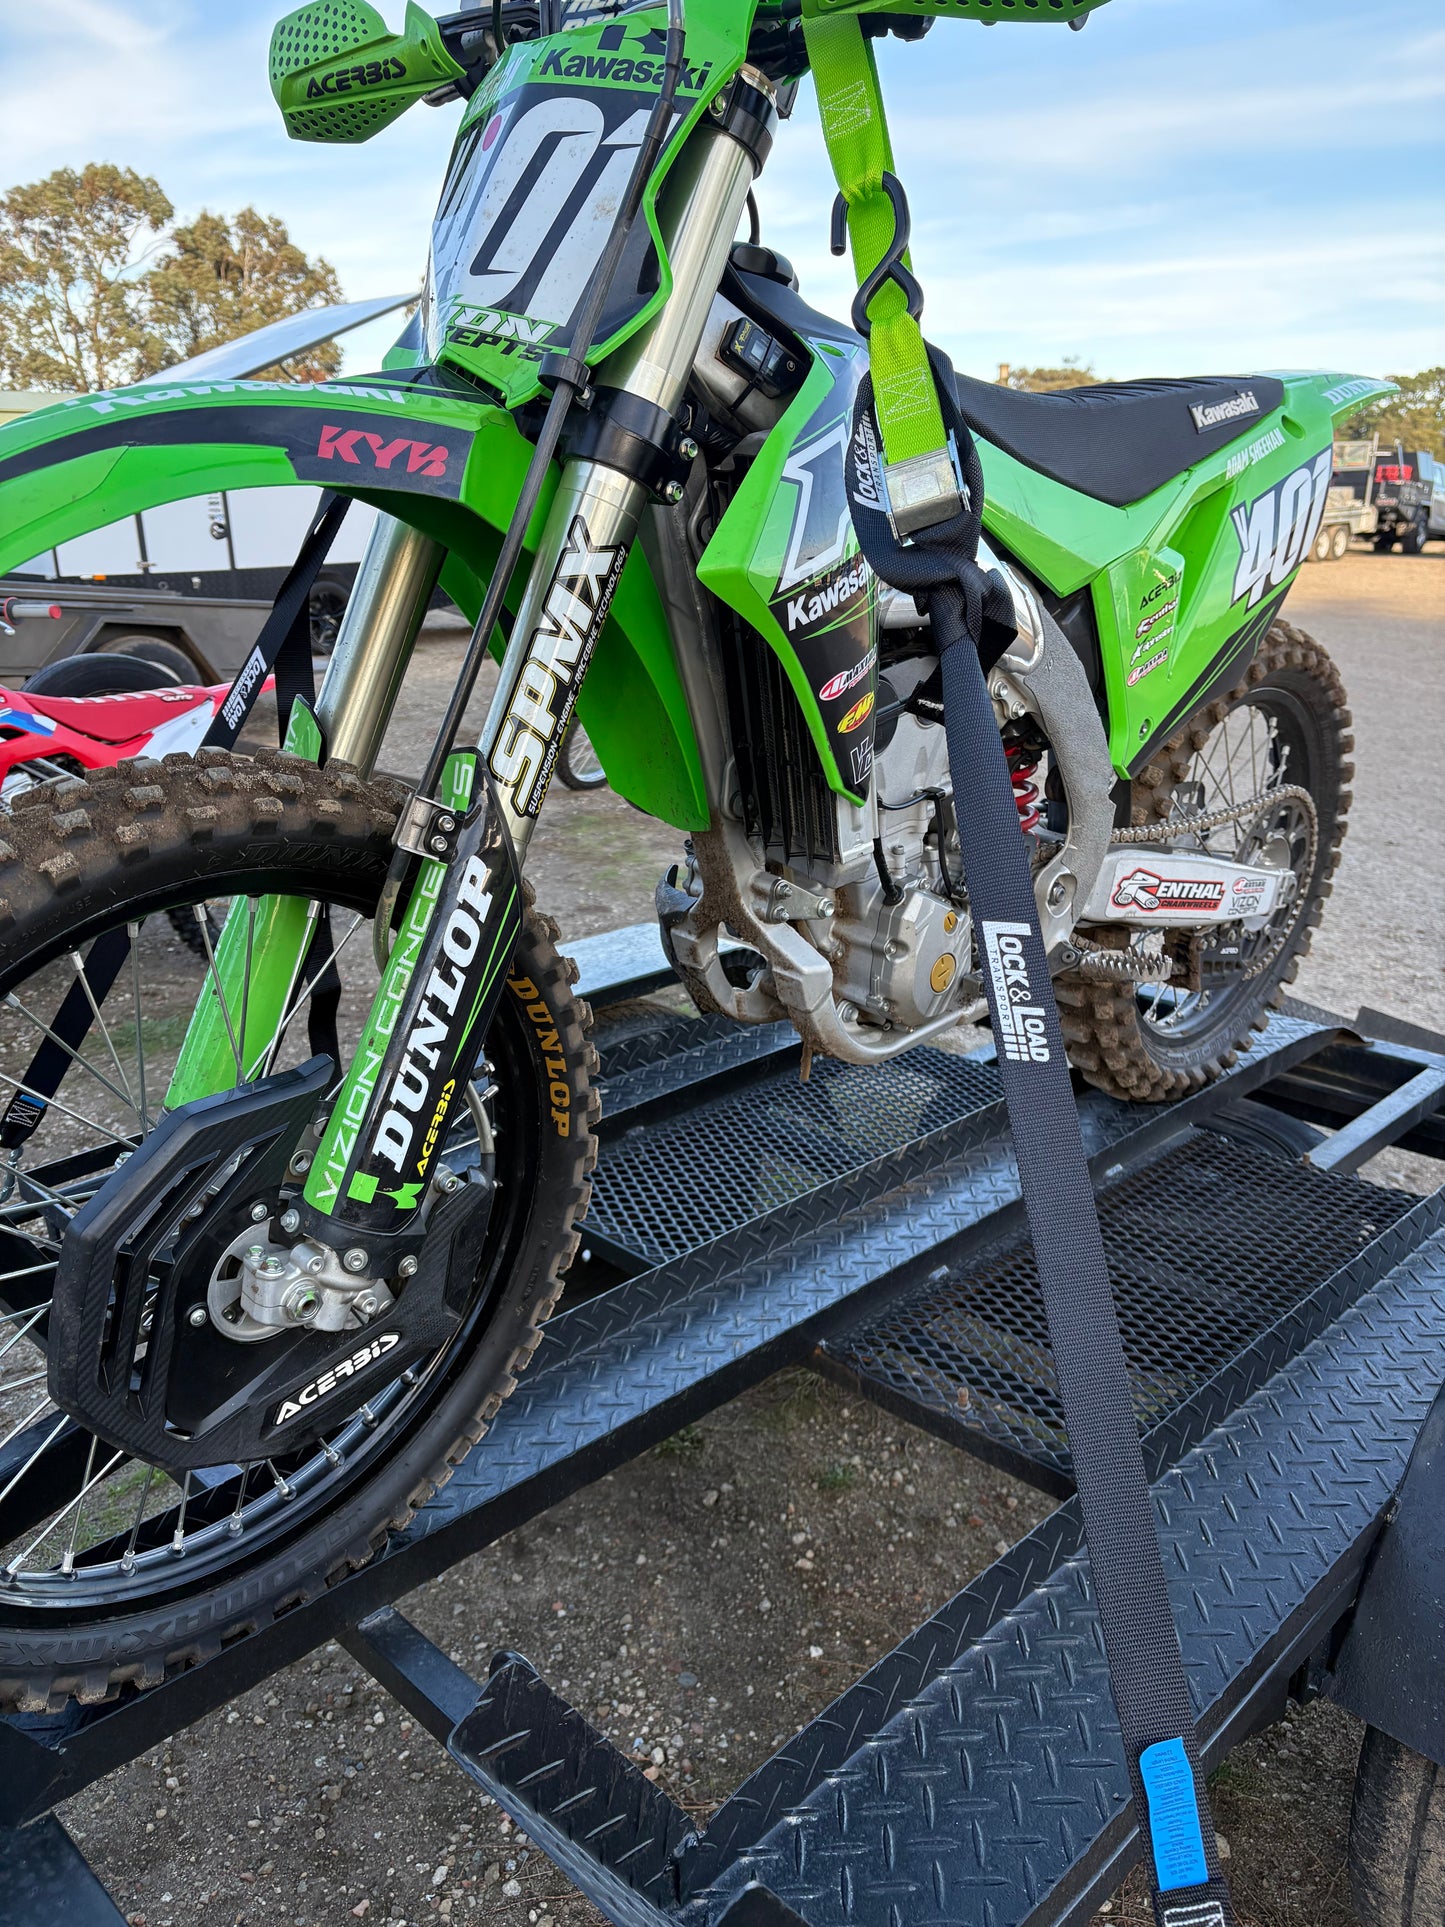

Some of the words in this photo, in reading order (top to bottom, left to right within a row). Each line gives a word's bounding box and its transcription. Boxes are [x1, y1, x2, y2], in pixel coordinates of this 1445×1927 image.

[306, 56, 407, 98] ACERBIS
[317, 424, 449, 477] KYB
[1192, 391, 1260, 428] Kawasaki
[1225, 448, 1249, 480] ADAM
[1249, 427, 1286, 466] SHEEHAN
[1232, 449, 1331, 609] 401
[491, 518, 616, 814] SPMX
[528, 740, 559, 815] SUSPENSION
[557, 690, 576, 734] ENGINE
[575, 626, 599, 685] RACEBIKE
[596, 546, 626, 624] TECHNOLOGY
[1115, 871, 1223, 909] RENTHAL
[1160, 900, 1219, 909] CHAINWHEELS
[372, 855, 494, 1173] DUNLOP
[990, 949, 1012, 1030] TRANSPORT
[507, 976, 571, 1138] DUNLOP
[316, 1050, 383, 1198] VIZION
[416, 1078, 456, 1177] ACERBIS
[276, 1334, 399, 1425] ACERBIS
